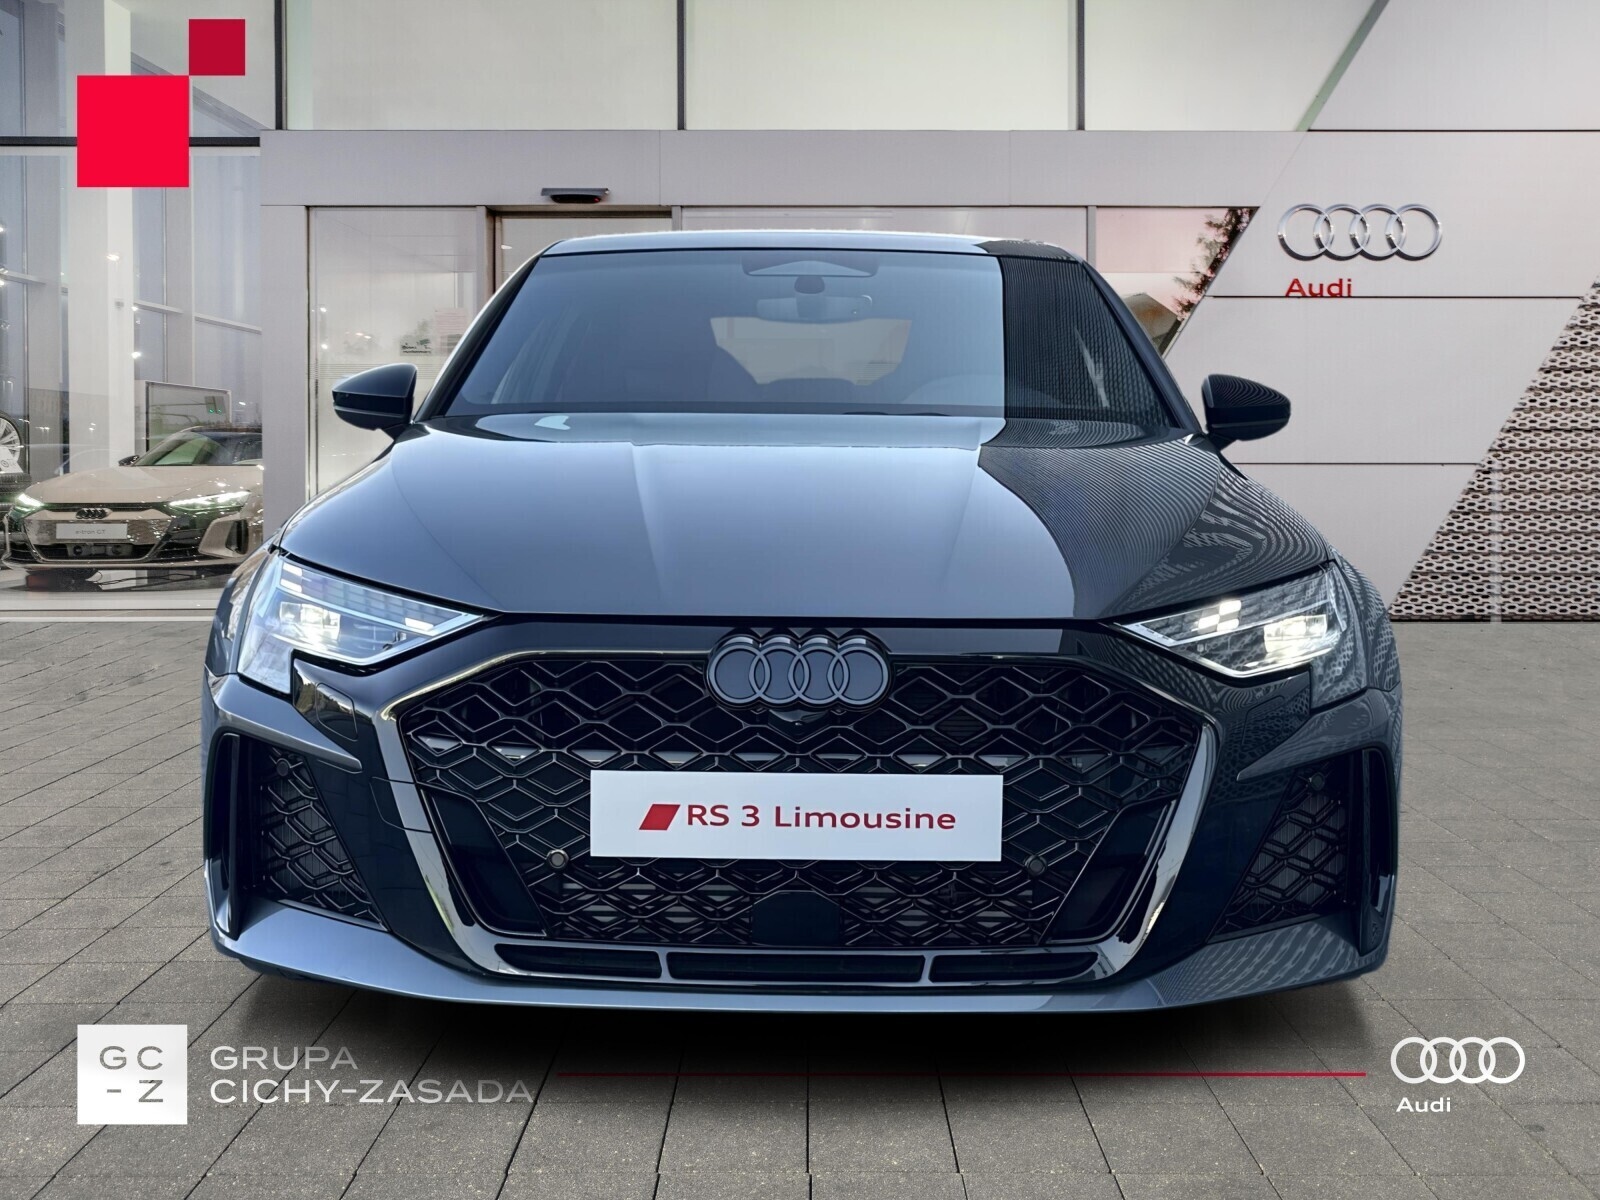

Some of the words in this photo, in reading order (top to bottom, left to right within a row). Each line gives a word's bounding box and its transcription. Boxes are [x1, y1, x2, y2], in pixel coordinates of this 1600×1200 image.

[1285, 278, 1352, 297] Audi
[687, 804, 730, 826] RS
[741, 805, 760, 827] 3
[774, 806, 956, 830] Limousine
